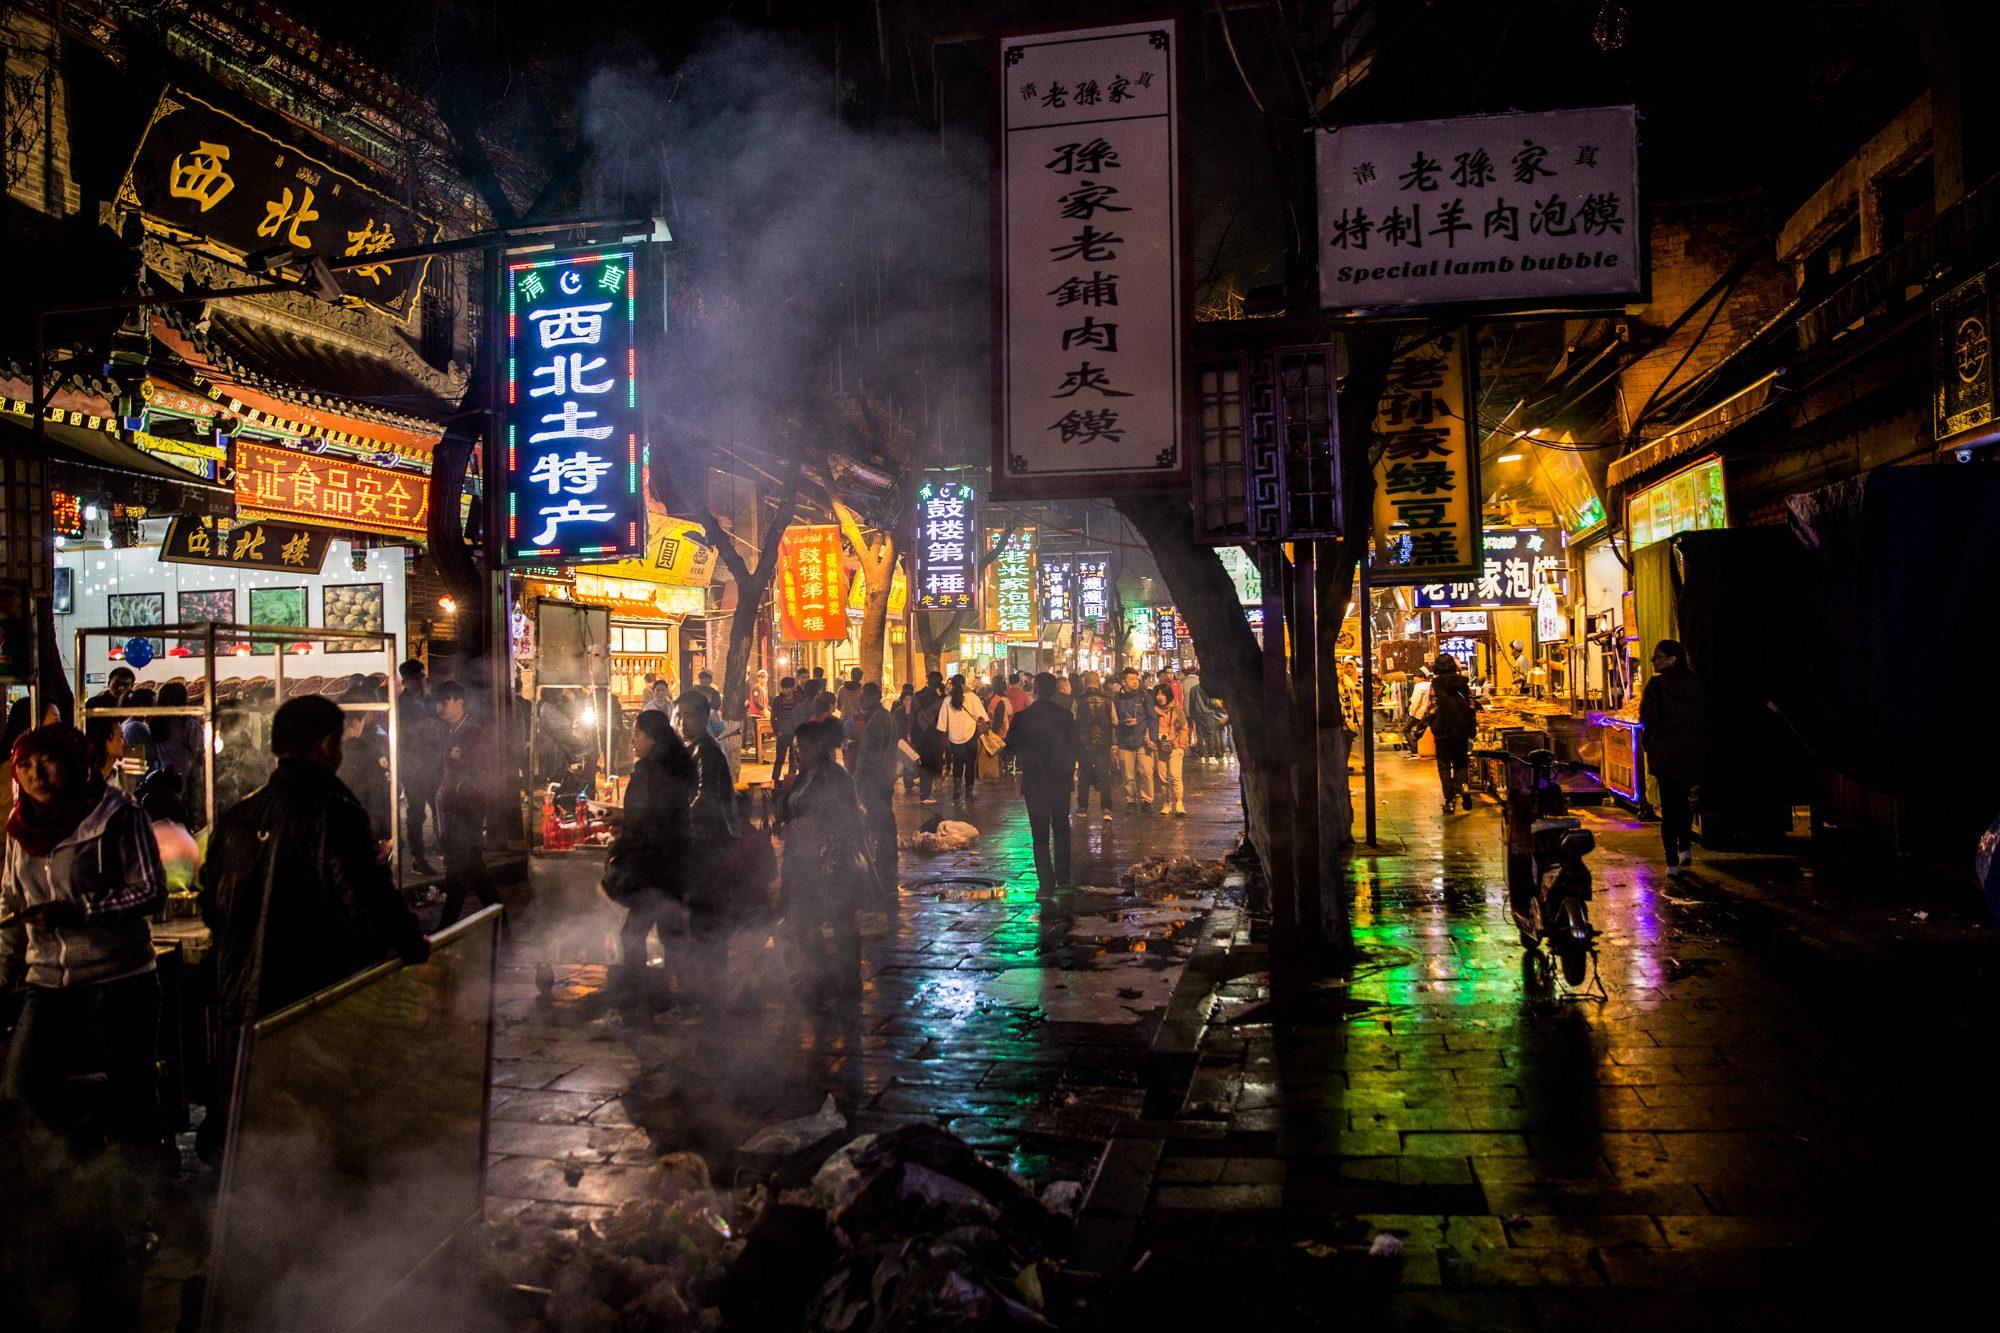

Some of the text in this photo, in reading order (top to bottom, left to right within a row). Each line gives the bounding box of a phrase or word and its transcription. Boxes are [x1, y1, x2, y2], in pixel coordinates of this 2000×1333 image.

[1019, 69, 1155, 109] 清 老孫家 真
[1353, 138, 1599, 192] 清 老孫家 真
[518, 264, 626, 303] 清 真
[1337, 251, 1619, 285] Special lamb bubble
[528, 302, 616, 545] 西北土特产
[921, 595, 970, 606] 老字号
